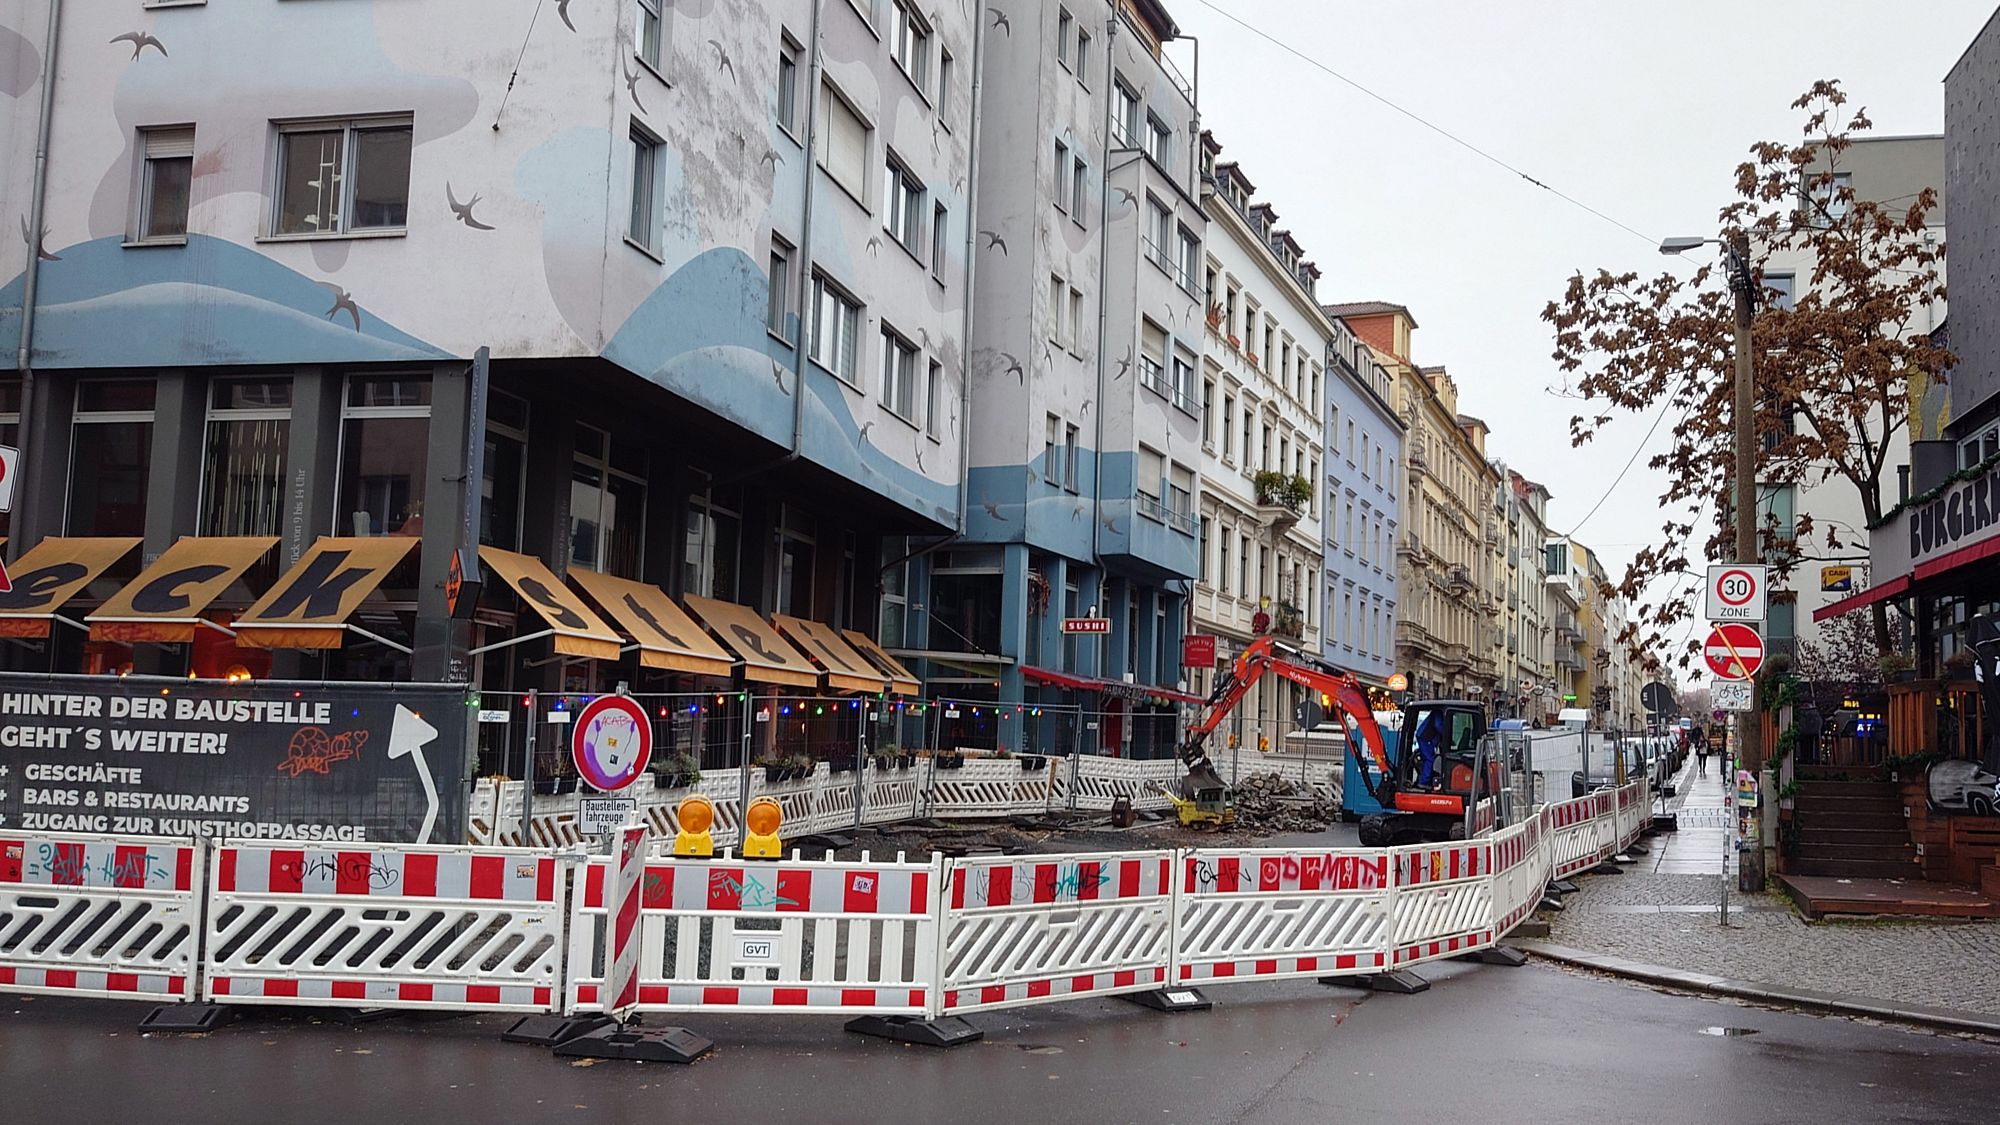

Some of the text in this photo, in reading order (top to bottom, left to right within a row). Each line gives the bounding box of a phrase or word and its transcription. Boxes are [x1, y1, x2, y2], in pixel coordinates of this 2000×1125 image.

[295, 468, 306, 487] Uhr
[293, 501, 304, 515] bis
[1725, 579, 1748, 596] 30
[1720, 607, 1750, 617] ZONE
[1068, 622, 1105, 631] SUSHI
[2, 693, 331, 725] HINTER DER BAUSTELLE
[111, 729, 228, 755] WEITER!
[25, 762, 142, 785] GESCHÄFTE
[23, 788, 79, 806] BARS
[84, 790, 99, 807] &
[104, 791, 250, 813] RESTAURANTS
[586, 801, 630, 812] Baustellen-
[586, 812, 624, 824] fahrzeuge
[22, 812, 108, 831] ZUGANG
[112, 816, 154, 834] ZUR
[159, 818, 366, 842] KUNSTHOFPASSAGE
[597, 823, 610, 834] frei
[746, 945, 768, 955] GVT
